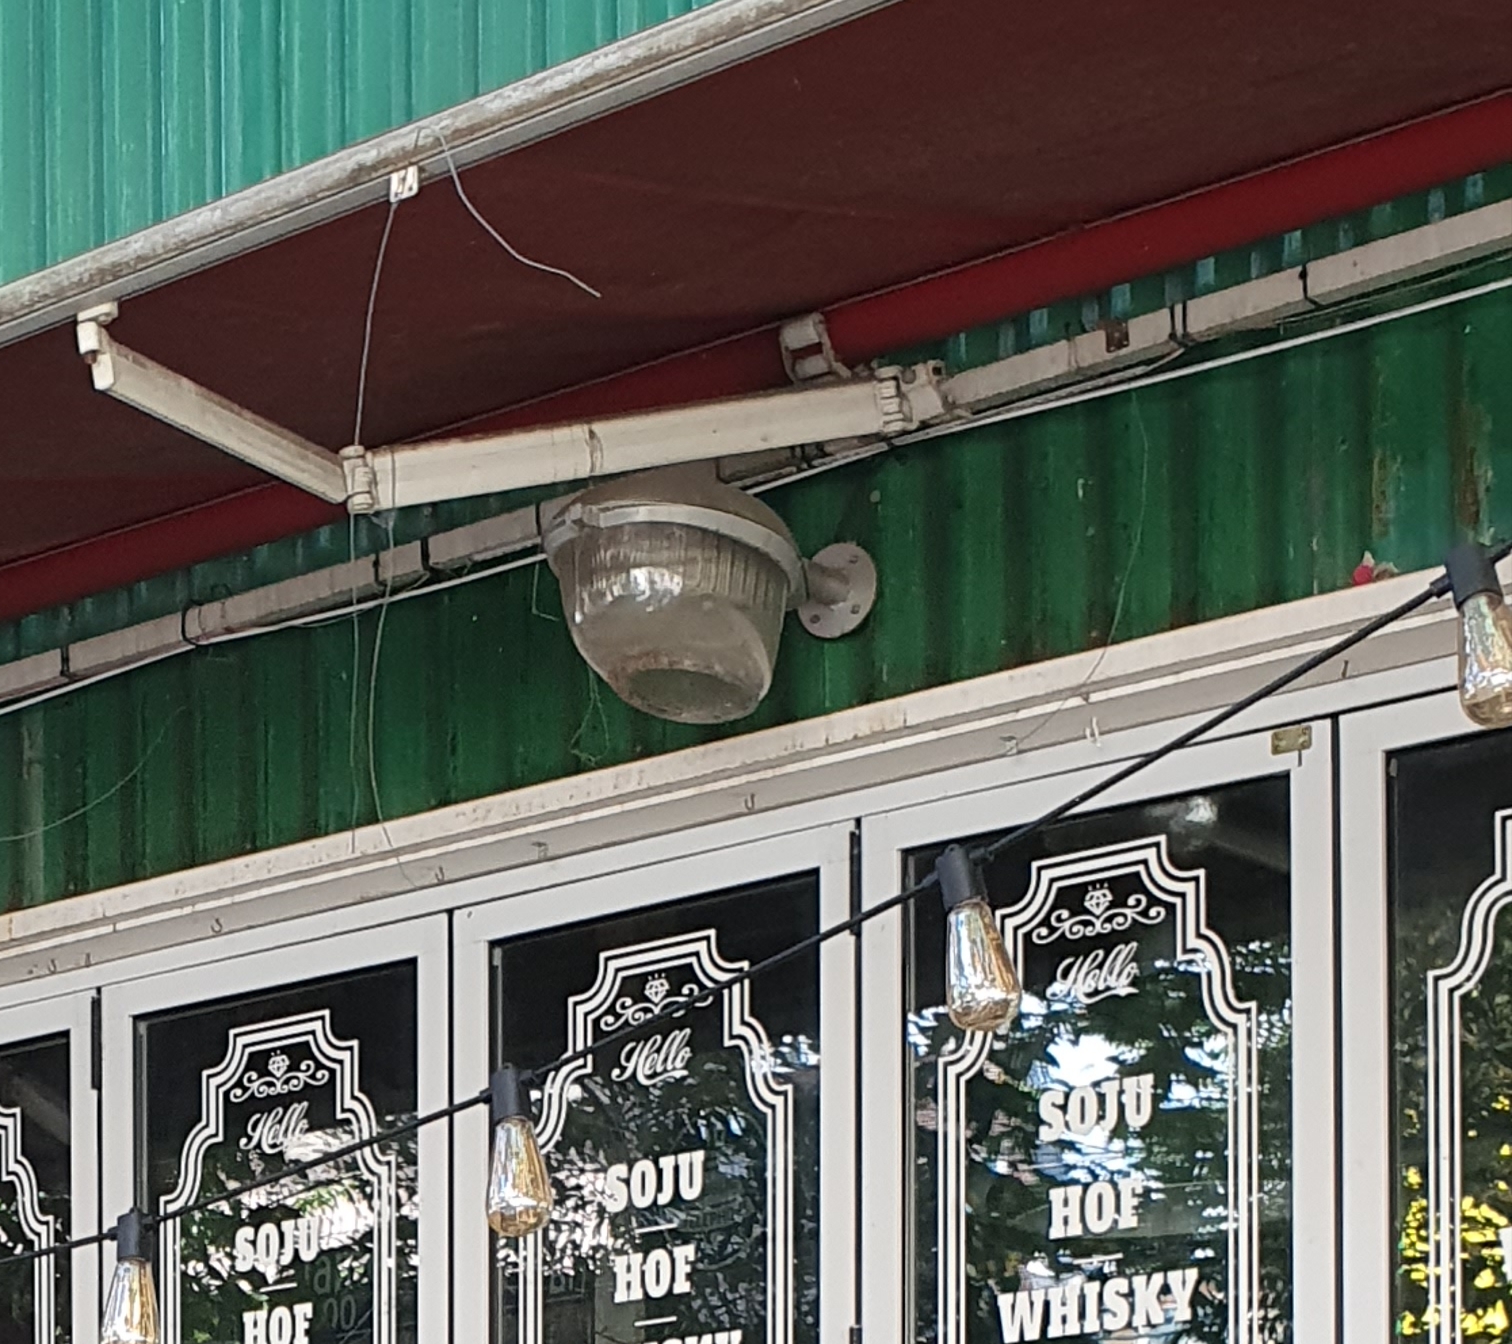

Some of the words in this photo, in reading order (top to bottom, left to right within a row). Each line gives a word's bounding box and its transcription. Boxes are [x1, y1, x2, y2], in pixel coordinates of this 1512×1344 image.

[1045, 941, 1140, 1003] Hello
[611, 1027, 692, 1086] Hello
[239, 1101, 310, 1156] Hello
[1037, 1073, 1155, 1143] SOJU
[605, 1150, 706, 1214] SOJU
[1048, 1178, 1144, 1241] HOF
[234, 1216, 321, 1273] SOJU
[613, 1244, 696, 1303] HOF
[996, 1268, 1199, 1344] WHISKY
